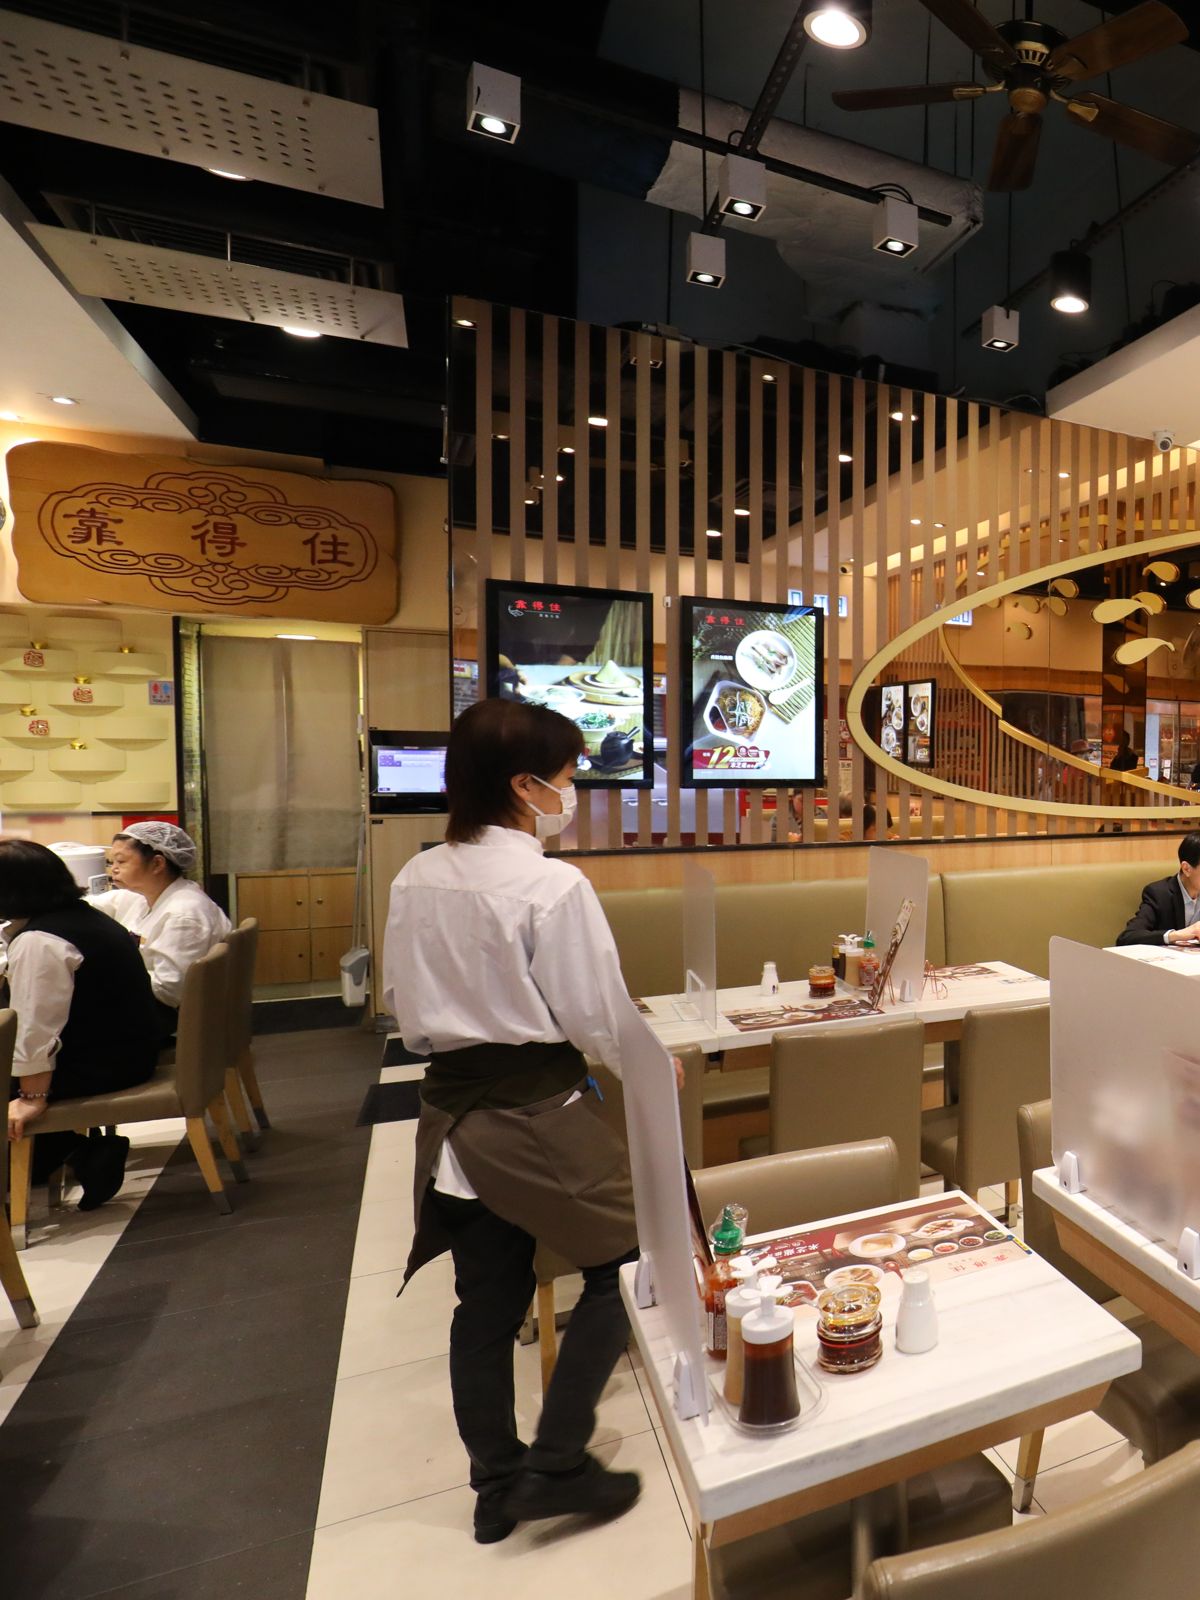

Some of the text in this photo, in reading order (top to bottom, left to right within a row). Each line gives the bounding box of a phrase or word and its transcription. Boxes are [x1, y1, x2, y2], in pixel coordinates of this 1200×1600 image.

[62, 507, 356, 568] 靠得住
[706, 745, 736, 769] 12
